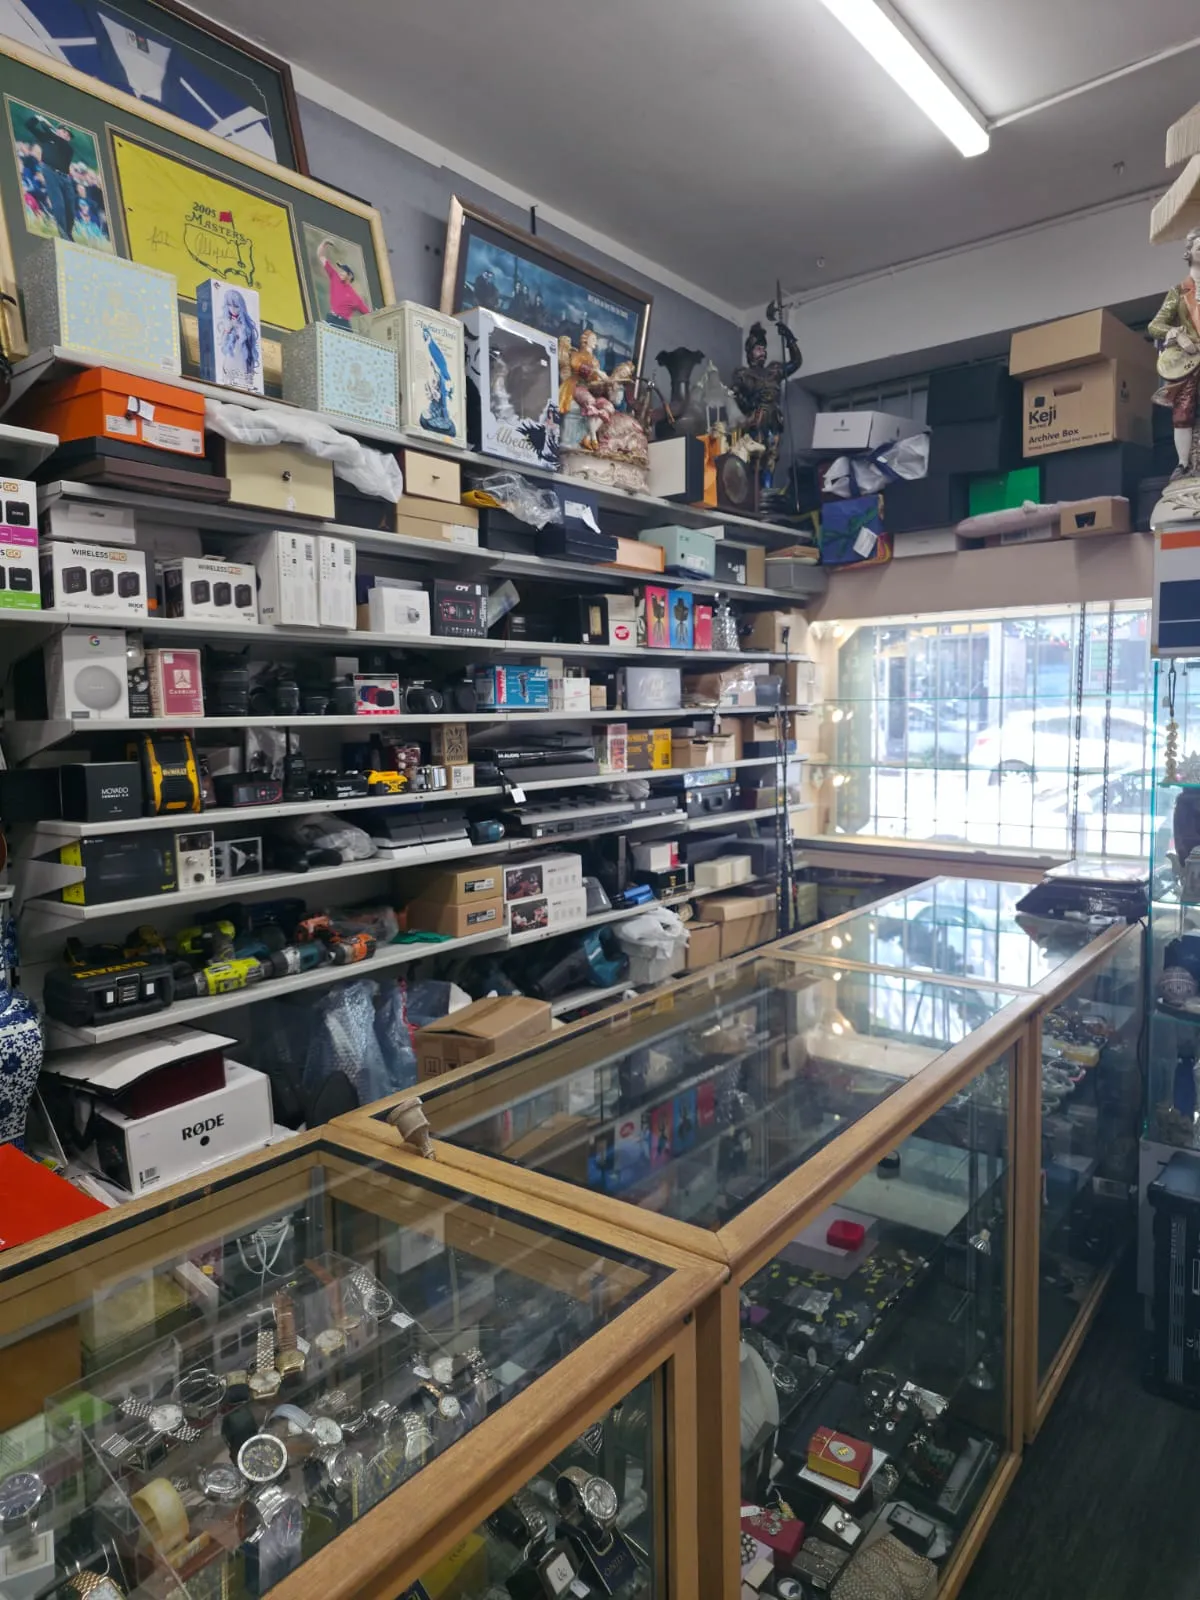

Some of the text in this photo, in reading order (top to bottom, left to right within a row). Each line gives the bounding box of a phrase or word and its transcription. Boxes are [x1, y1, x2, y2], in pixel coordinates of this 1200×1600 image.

[192, 201, 217, 218] 2005
[1028, 404, 1057, 426] Keji
[1028, 433, 1060, 445] Archive
[1062, 428, 1079, 438] Box
[2, 482, 19, 492] GO
[71, 548, 109, 559] WIRELESS
[101, 786, 129, 795] MOVADO
